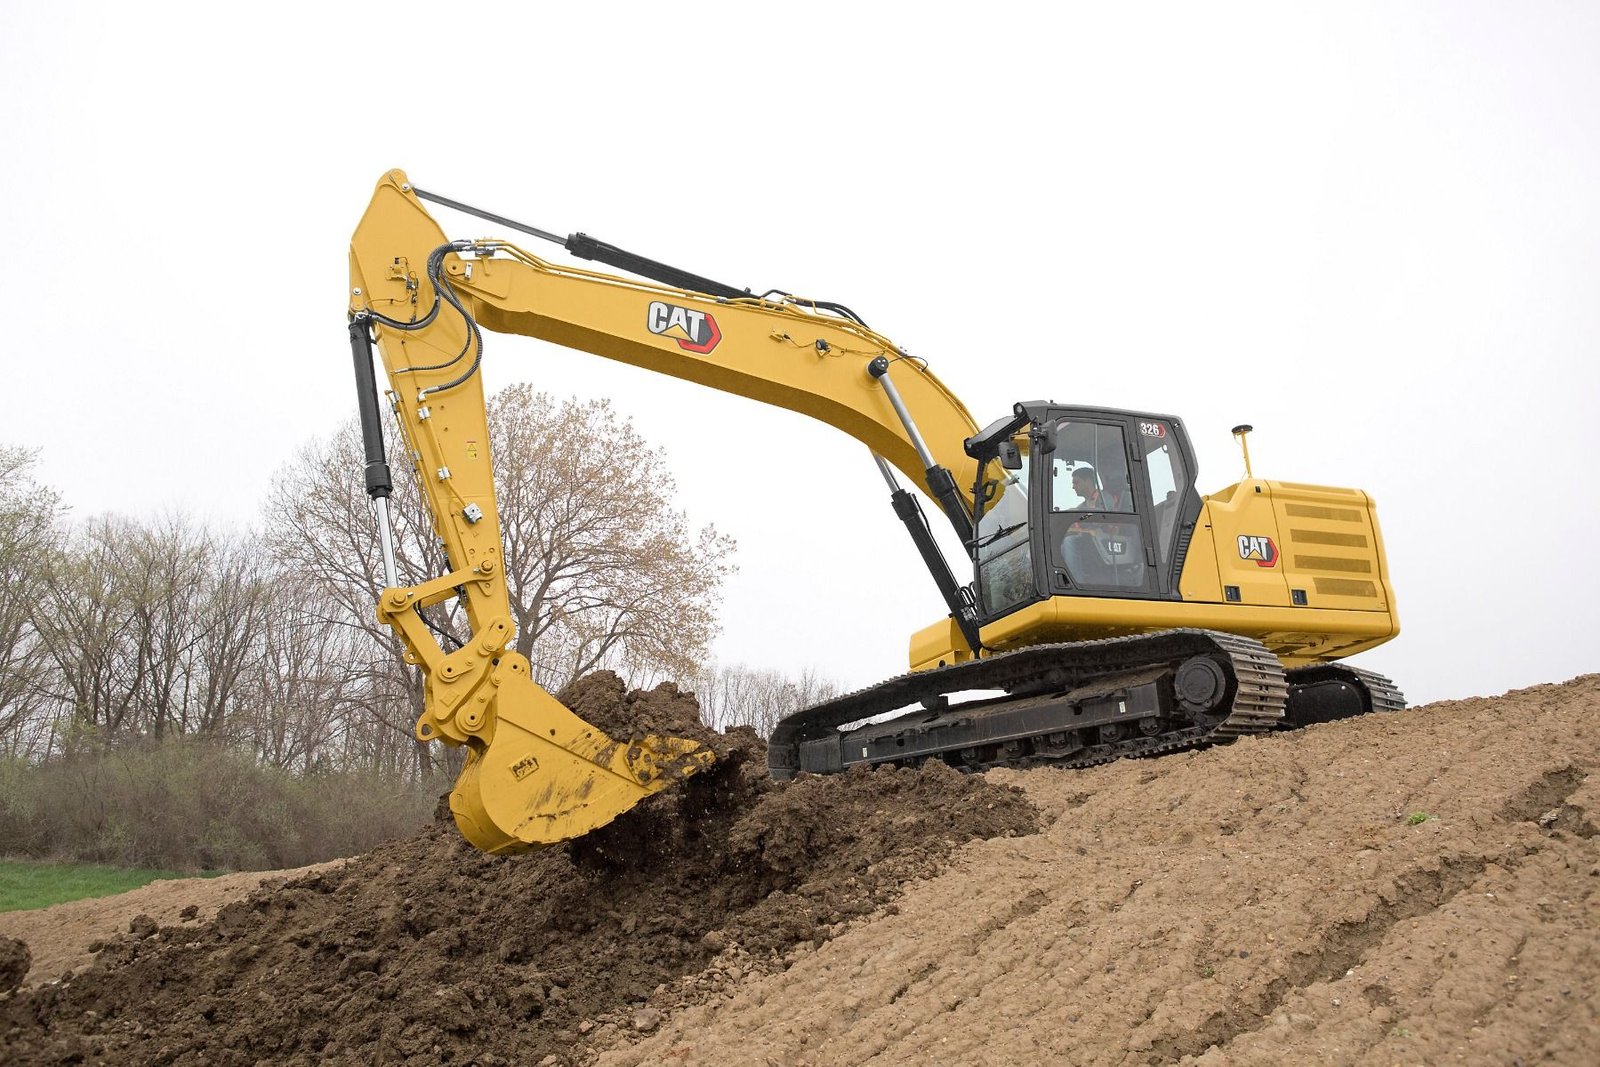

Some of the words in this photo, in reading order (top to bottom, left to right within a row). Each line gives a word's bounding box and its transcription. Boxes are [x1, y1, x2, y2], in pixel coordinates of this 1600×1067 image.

[648, 301, 704, 343] CAT
[1140, 422, 1159, 436] 326
[1238, 535, 1268, 560] CAT
